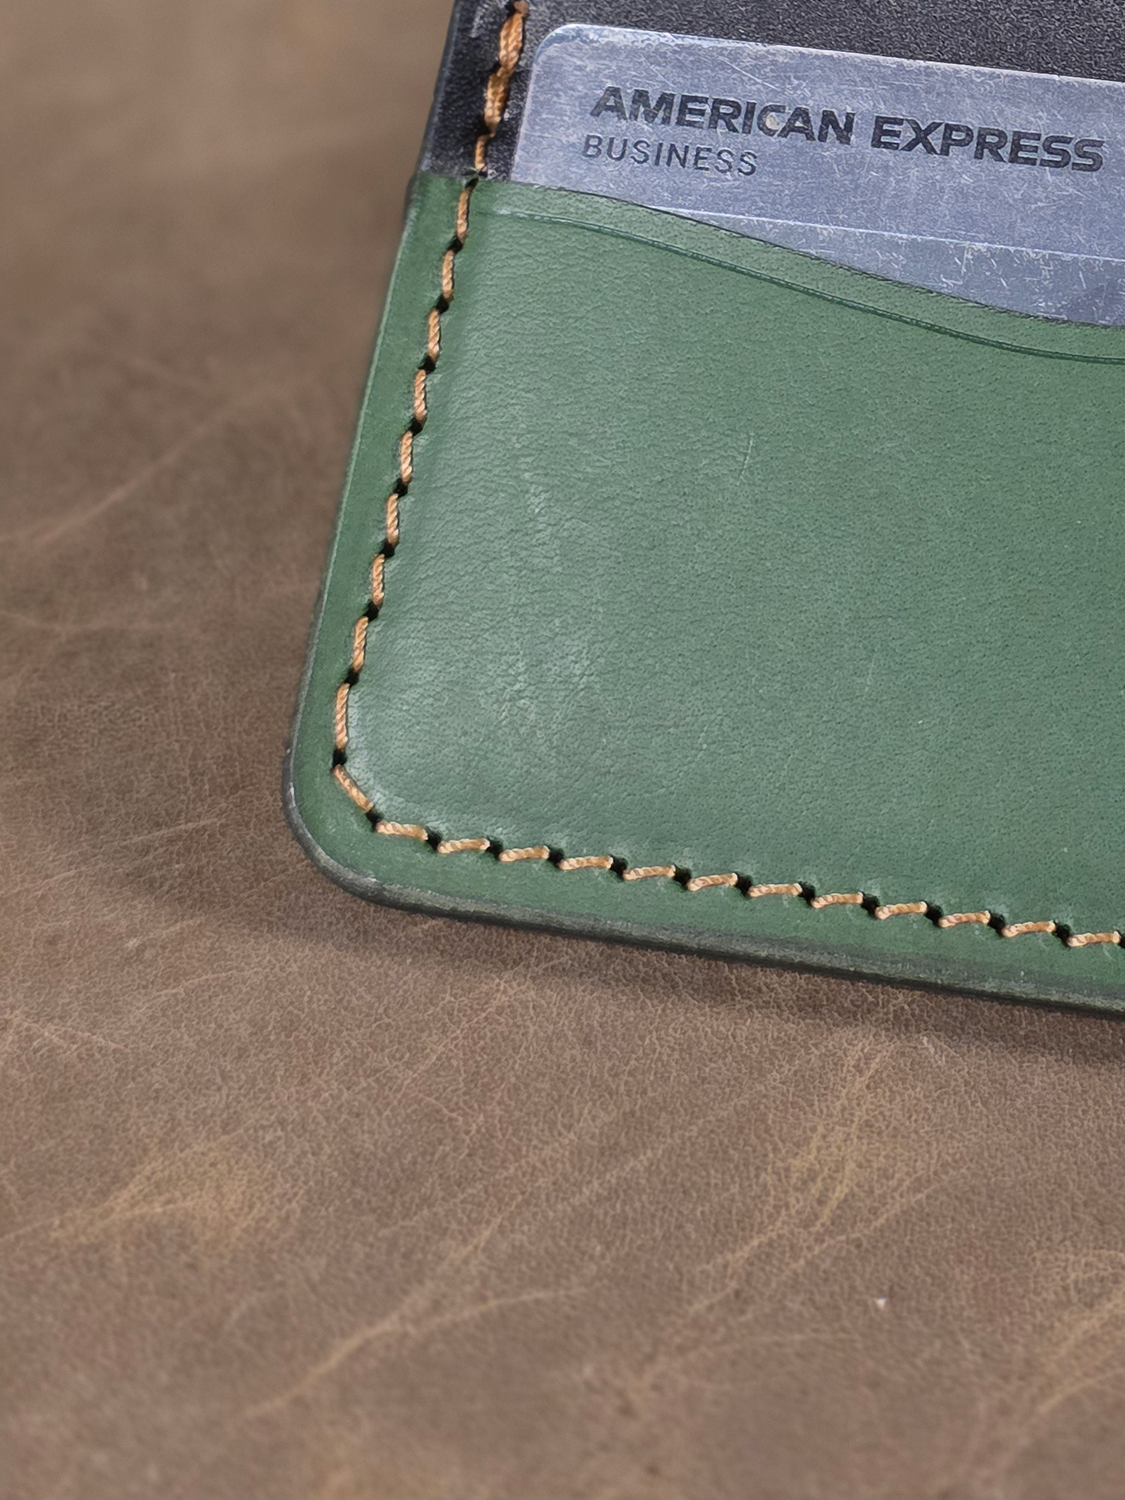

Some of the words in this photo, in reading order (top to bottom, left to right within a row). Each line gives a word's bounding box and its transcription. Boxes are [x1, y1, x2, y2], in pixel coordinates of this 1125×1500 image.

[582, 134, 758, 178] BUSINESS
[590, 86, 855, 145] AMERICAN
[870, 115, 1105, 173] EXPRESS
